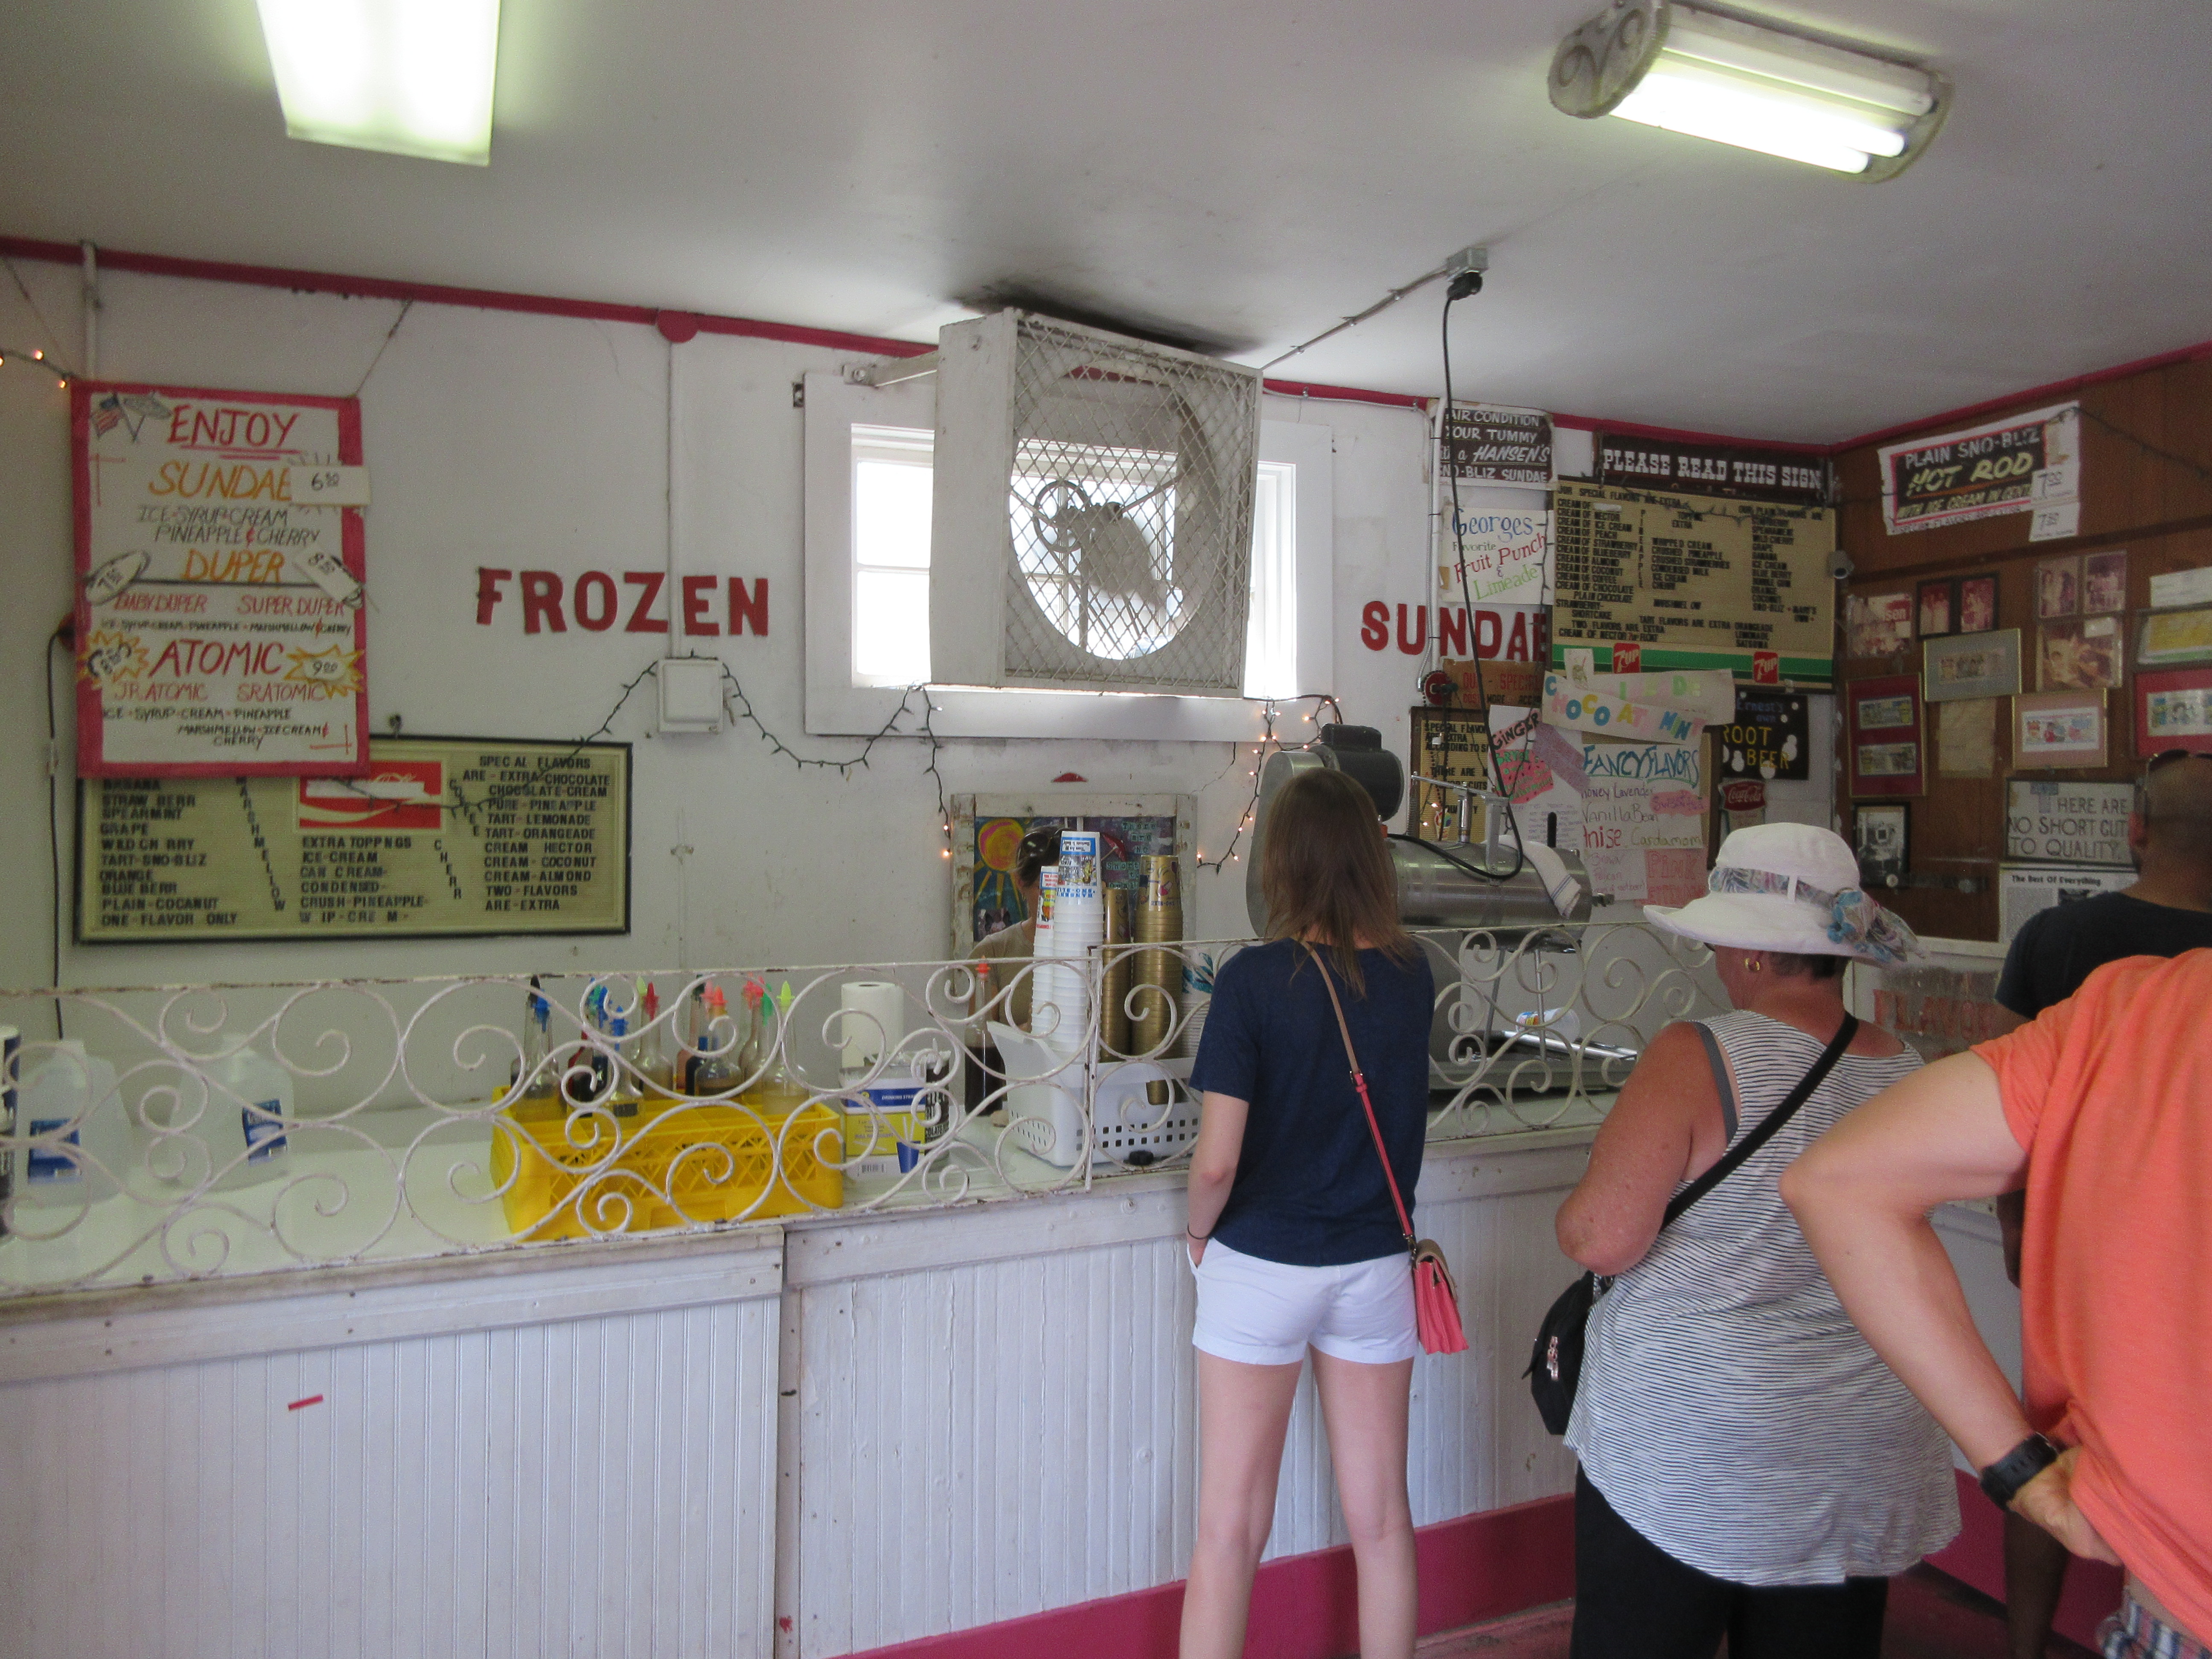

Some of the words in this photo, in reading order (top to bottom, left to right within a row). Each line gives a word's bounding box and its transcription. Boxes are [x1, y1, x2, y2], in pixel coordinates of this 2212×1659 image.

[167, 404, 300, 447] ENJOY
[1474, 411, 1540, 427] CONDITION
[1487, 429, 1537, 443] TUMMY
[1471, 442, 1551, 463] HANSEN'S
[1905, 446, 1951, 469] PLAIN
[1501, 468, 1548, 483] SUNDAE
[1603, 448, 1671, 476] PLEASE
[1678, 455, 1727, 481] READ
[1732, 461, 1777, 485] THIS
[1781, 466, 1822, 489] SIGN
[1970, 452, 2033, 482] ROD
[148, 460, 292, 502] SUNDAE
[229, 508, 288, 527] CREAM
[1452, 508, 1534, 543] Georges
[155, 525, 242, 545] PINEAPPLE
[256, 527, 320, 547] CHERRY
[1452, 541, 1496, 552] Fvorite
[1498, 532, 1547, 567] Punch
[182, 548, 285, 587] DUPER
[1473, 564, 1538, 601] Limeade
[237, 595, 294, 616] SUPER
[297, 597, 345, 617] DUPER
[476, 567, 768, 636] FROZEN
[148, 638, 285, 678] ATOMIC
[144, 683, 209, 702] ATOMIC
[181, 708, 224, 720] CREAM
[1659, 710, 1707, 741] MINT
[1746, 749, 1790, 769] BEER
[463, 770, 486, 781] ARE
[544, 774, 610, 786] CHOCOLATE
[566, 786, 607, 797] CREAM
[2101, 798, 2129, 815] ARE
[488, 814, 517, 824] TART
[526, 814, 591, 826] LEMONADE
[2038, 816, 2096, 836] SHORT
[303, 836, 345, 849] EXTRA
[486, 828, 514, 839] TART
[524, 828, 596, 839] ORANGEADE
[485, 842, 528, 853] CREAM
[2008, 836, 2037, 855] TO
[329, 851, 378, 863] CREAM
[484, 856, 529, 868] CREAM
[484, 871, 531, 882] CREAM
[539, 871, 592, 882] ALMOND
[2012, 875, 2025, 883] The
[2028, 875, 2044, 883] Best
[2059, 876, 2102, 886] Everything
[486, 885, 512, 896] TWO
[524, 885, 578, 896] FLAVORS
[102, 897, 146, 911] PLAIN
[485, 899, 511, 911] ARE
[520, 899, 560, 911] EXTRA
[140, 913, 194, 926] FLAVOR
[206, 912, 237, 926] ONLY
